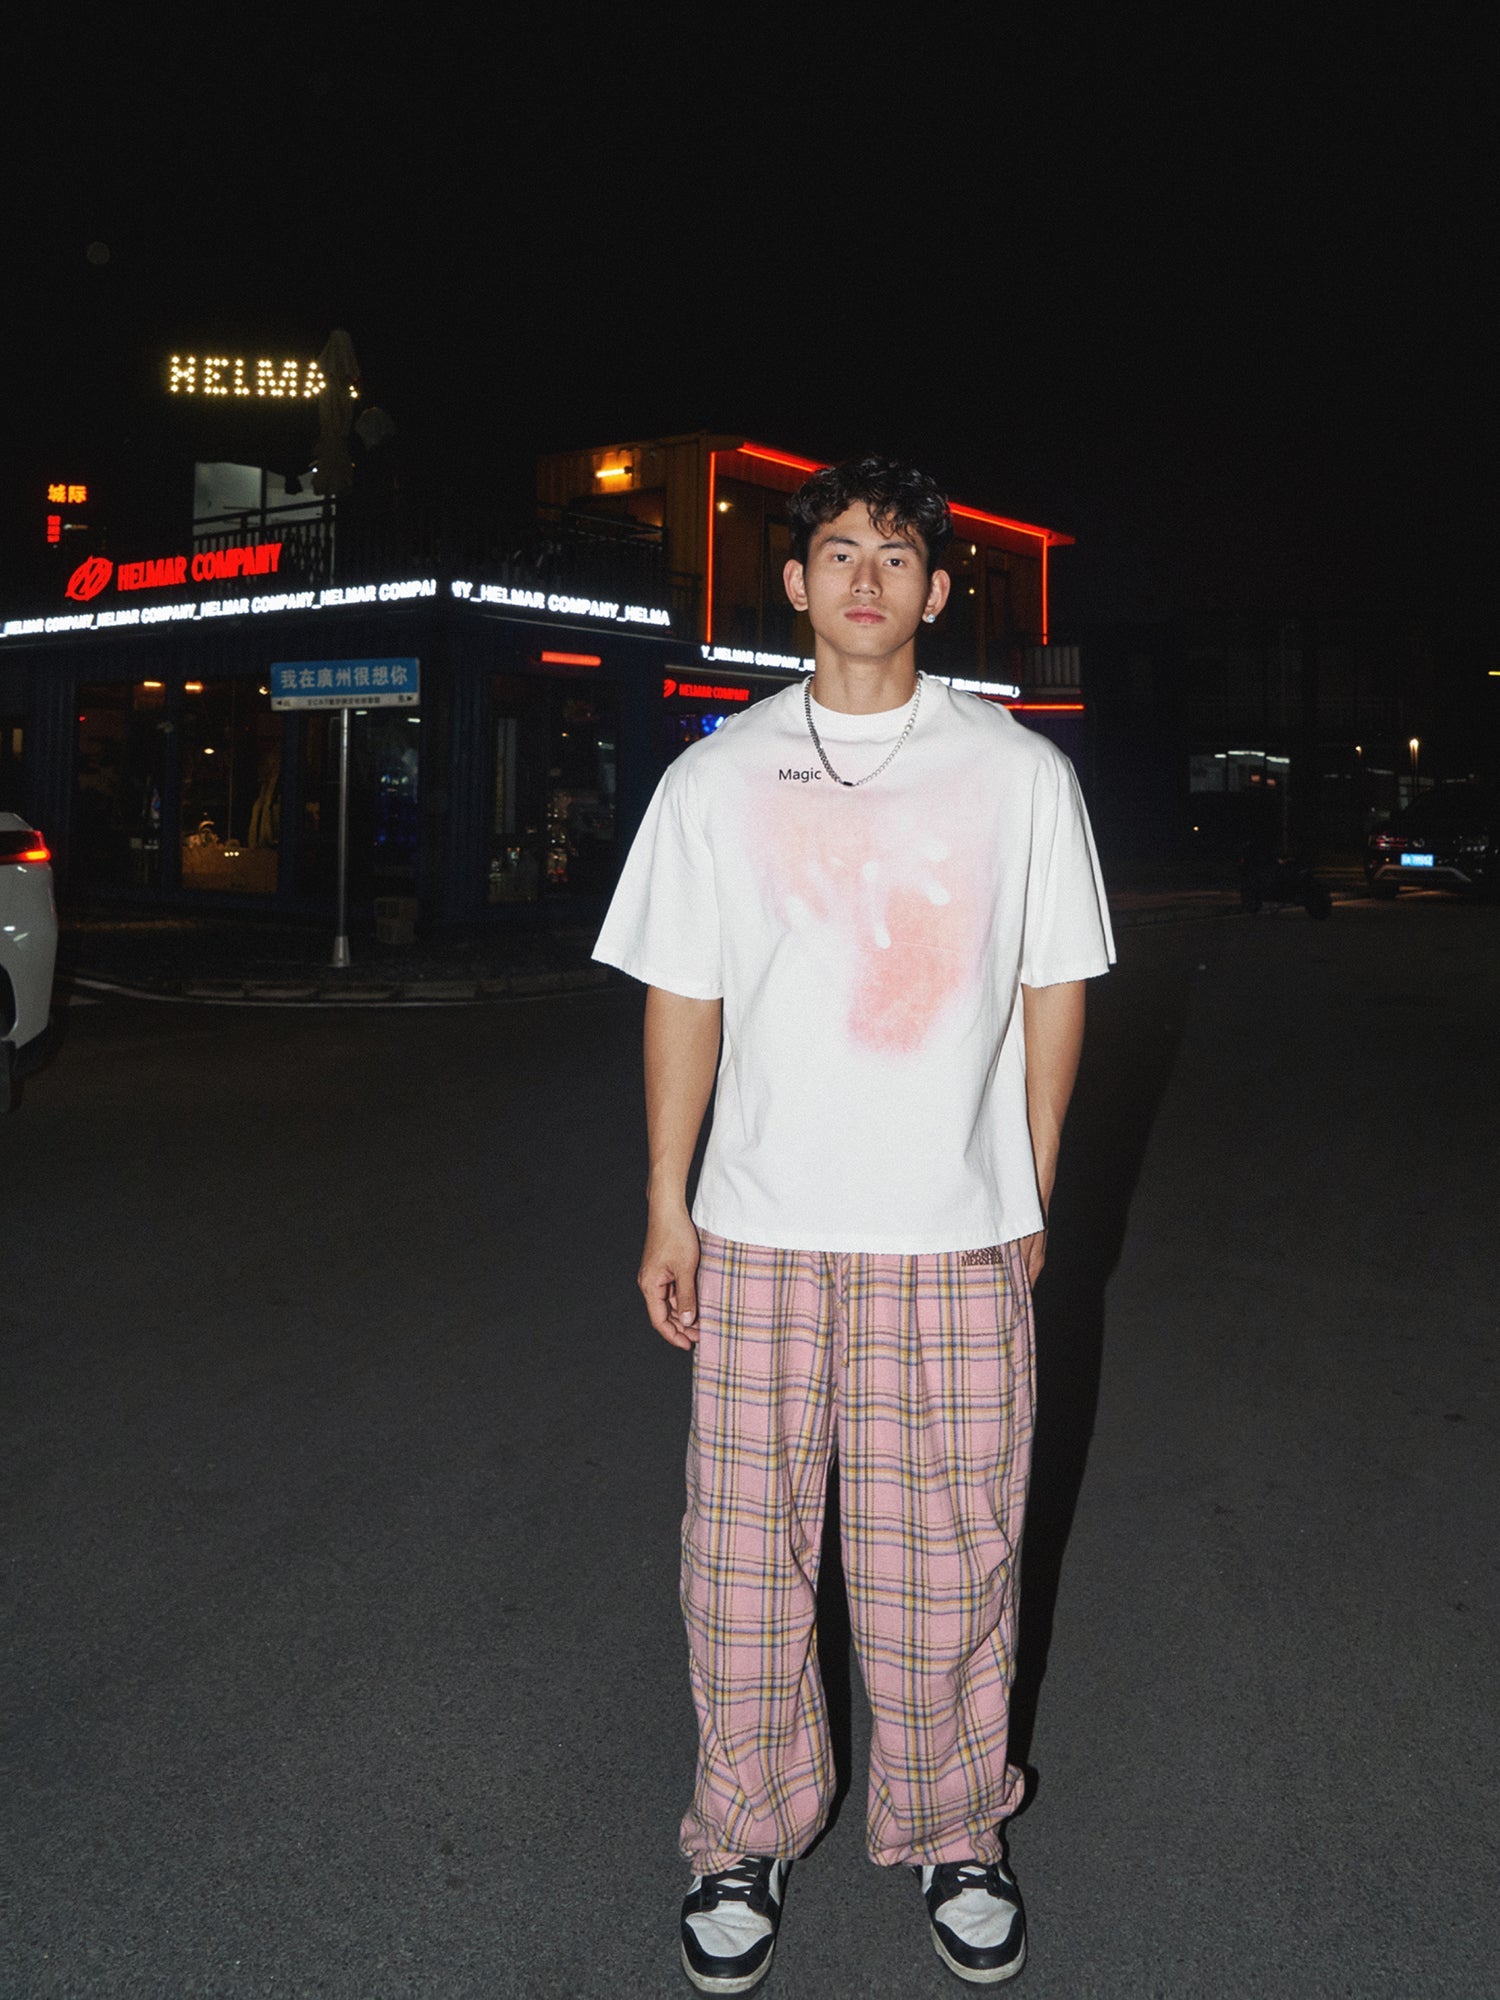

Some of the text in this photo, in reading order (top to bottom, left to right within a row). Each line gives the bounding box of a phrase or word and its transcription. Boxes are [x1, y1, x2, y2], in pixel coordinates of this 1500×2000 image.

[118, 543, 281, 590] HELMAR COMPANY
[279, 664, 408, 689] 我在廣州很想你
[679, 684, 713, 697] HELMAR
[778, 768, 822, 783] Magic
